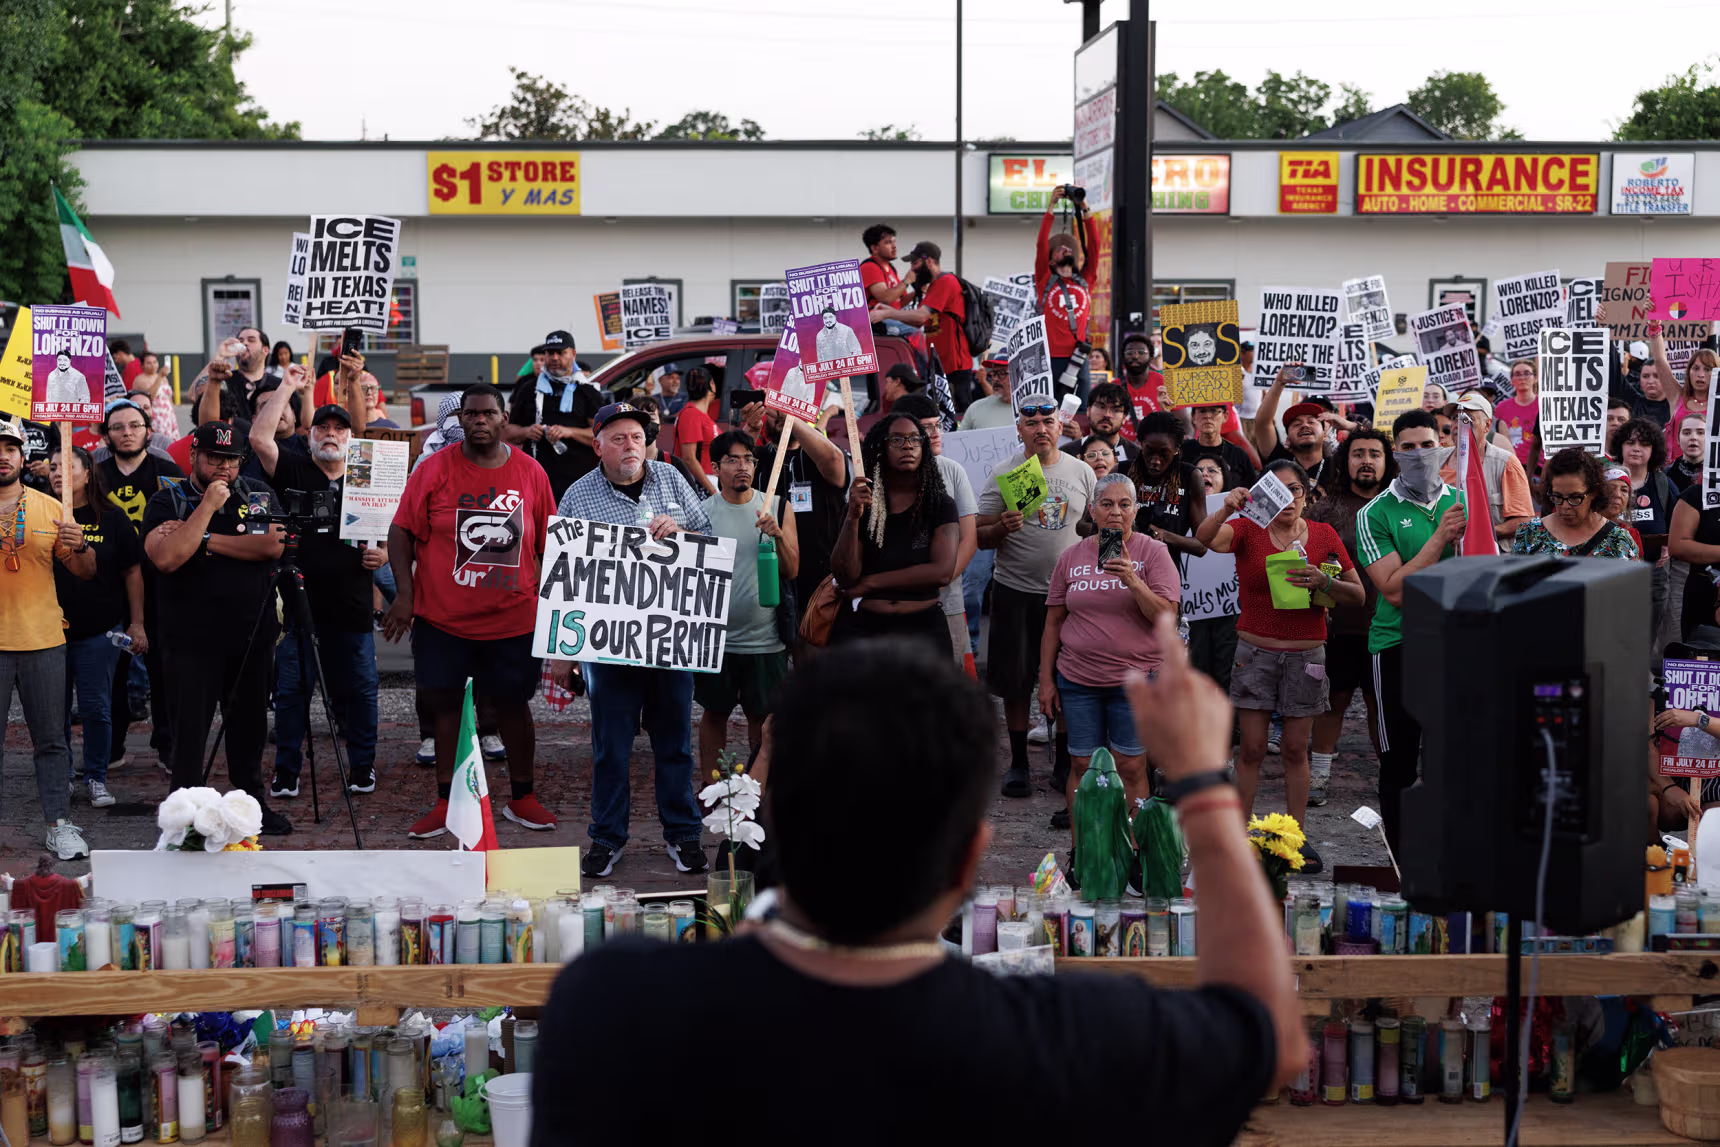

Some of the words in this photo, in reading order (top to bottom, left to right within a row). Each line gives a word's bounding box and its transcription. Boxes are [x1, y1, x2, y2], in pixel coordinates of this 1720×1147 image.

[1002, 159, 1057, 187] EL
[1364, 157, 1592, 193] INSURANCE
[432, 162, 482, 205] $1
[487, 161, 575, 183] STORE
[1621, 186, 1661, 195] INCOME
[1665, 187, 1685, 196] TAX
[1627, 178, 1679, 187] ROBERTO
[500, 188, 515, 206] Y
[523, 188, 575, 206] MAS
[1285, 194, 1332, 202] INSURANCE
[1291, 202, 1326, 210] AGENCY
[1362, 196, 1399, 212] AUTO
[1409, 196, 1447, 211] HOME
[1458, 195, 1544, 211] COMMERCIAL
[1555, 195, 1592, 211] SR-22
[1643, 203, 1689, 212] TRANSFER
[314, 218, 395, 243] ICE
[310, 240, 392, 273] MELTS
[799, 268, 827, 276] BUSINESS
[307, 277, 326, 299] IN
[332, 275, 388, 299] TEXAS
[789, 277, 815, 295] SHUT
[817, 275, 828, 289] IT
[829, 269, 861, 286] DOWN
[815, 286, 838, 295] FOR
[985, 279, 1014, 296] JUSTICE
[1014, 285, 1029, 298] FOR
[1497, 281, 1522, 297] WHO
[1524, 275, 1558, 291] KILLED
[622, 287, 653, 298] RELEASE
[653, 286, 666, 297] THE
[305, 300, 385, 316] HEAT!
[623, 297, 669, 317] NAMES!
[792, 286, 865, 319] LORENZO
[1263, 293, 1292, 310] WHO
[1296, 294, 1339, 313] KILLED
[1500, 290, 1560, 318] LORENZO?
[33, 316, 57, 331] SHUT
[59, 317, 70, 330] IT
[71, 317, 104, 333] DOWN
[624, 317, 642, 328] JAIL
[644, 315, 671, 325] KILLER
[763, 315, 786, 328] LORE
[1260, 313, 1337, 339] LORENZO?
[1416, 310, 1456, 331] JUSTICE
[1503, 319, 1543, 340] RELEASE
[1545, 316, 1564, 329] THE
[626, 327, 671, 339] ICE
[1025, 320, 1043, 342] FOR
[1600, 323, 1707, 338] MMIANTS
[34, 333, 104, 357] LORENZO
[1339, 340, 1366, 362] LTS
[1541, 331, 1604, 355] ICE
[1257, 341, 1308, 363] RELEASE
[1312, 344, 1334, 364] THE
[1667, 351, 1690, 361] ALGADO
[806, 364, 817, 375] FRI
[818, 361, 834, 373] JULY
[835, 359, 846, 369] 24
[847, 356, 856, 367] AT
[857, 354, 873, 365] 6PM
[1256, 364, 1332, 378] NAS!
[1426, 348, 1475, 376] LORENZO
[1336, 363, 1367, 380] EXAS
[1430, 371, 1462, 385] SALGADO
[1541, 356, 1604, 392] MELTS
[1176, 379, 1231, 392] SALGADO
[1382, 387, 1419, 396] JUSTICIA
[768, 390, 777, 400] FRI
[777, 392, 793, 403] JULY
[792, 398, 800, 408] 24
[800, 400, 807, 410] AT
[806, 402, 818, 415] 6PM
[1176, 388, 1232, 404] ARAUJO
[34, 405, 44, 413] FRI
[45, 405, 58, 413] JULY
[60, 405, 70, 413] 24
[72, 405, 81, 413] AT
[83, 405, 99, 413] 6PM
[1542, 397, 1552, 421] IN
[1552, 396, 1602, 421] TEXAS
[215, 428, 232, 446] M
[1543, 424, 1602, 441] HEAT!
[547, 518, 584, 546] The
[586, 521, 719, 570] FIRST
[1069, 565, 1091, 579] ICE
[539, 551, 733, 619] AMENDMENT
[1068, 579, 1128, 593] HOUSTO
[546, 609, 587, 656] IS
[589, 619, 643, 660] OUR
[646, 614, 727, 669] PERMIT
[1665, 670, 1694, 684] SHUT
[1696, 671, 1706, 685] IT
[1665, 687, 1720, 711] LOREN
[1663, 757, 1674, 766] FRI
[1676, 758, 1693, 768] JULY
[1695, 759, 1705, 768] 24
[1707, 760, 1717, 768] AT
